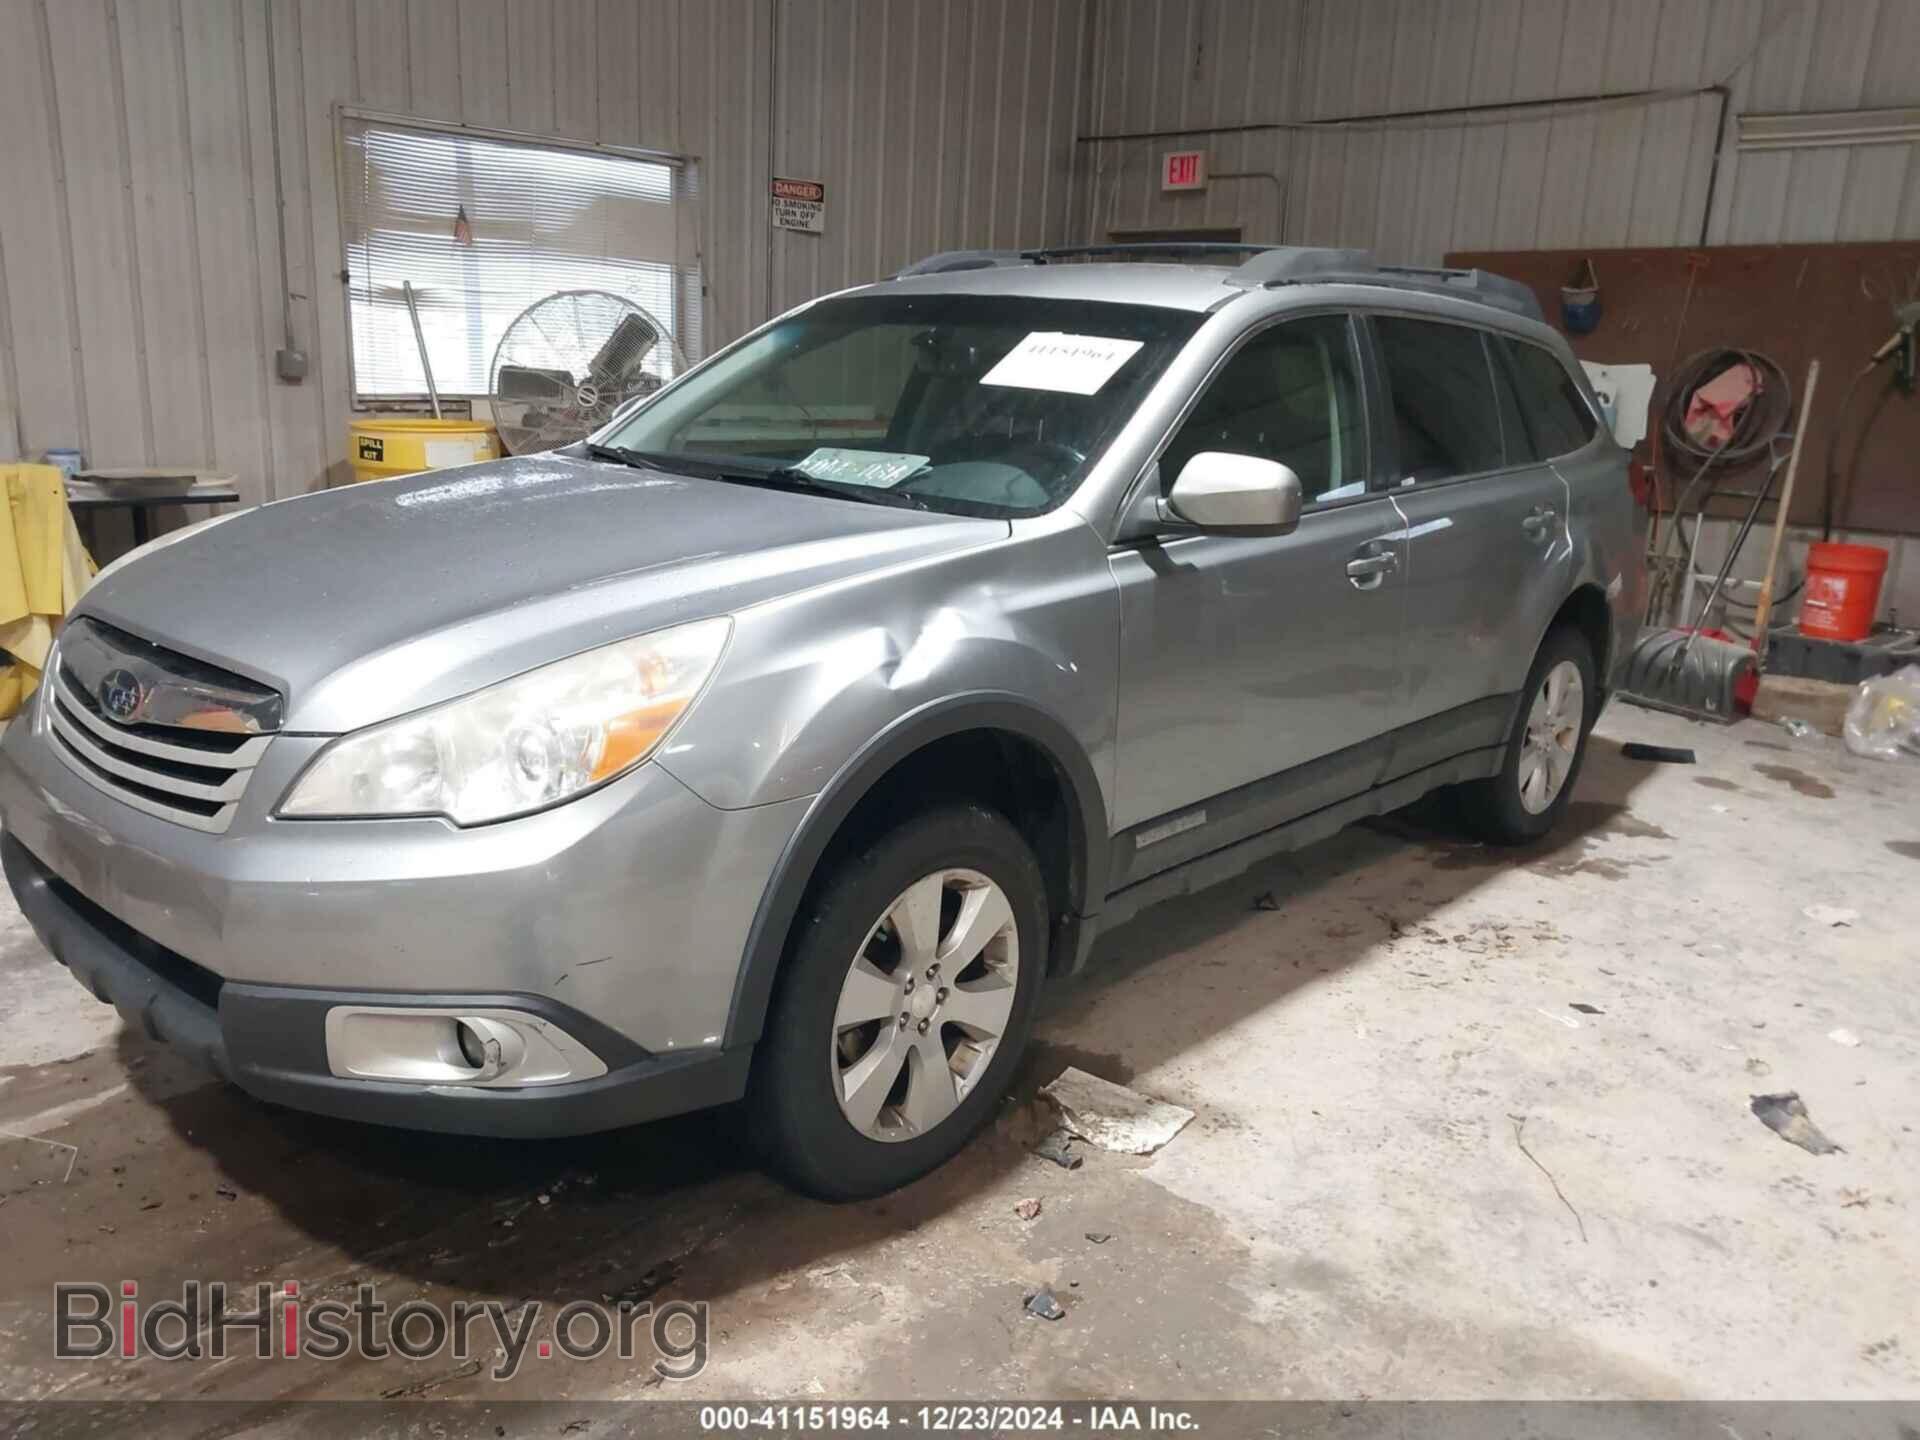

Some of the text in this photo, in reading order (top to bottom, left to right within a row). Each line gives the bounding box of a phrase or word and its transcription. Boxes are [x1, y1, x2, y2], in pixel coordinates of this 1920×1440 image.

[1170, 155, 1199, 184] EXIT
[775, 182, 817, 198] DANGER
[784, 200, 822, 212] SMOKING
[775, 207, 816, 220] TURN OFF
[780, 217, 810, 229] ENGINE
[359, 438, 382, 449] SPILL
[363, 450, 377, 460] KIT
